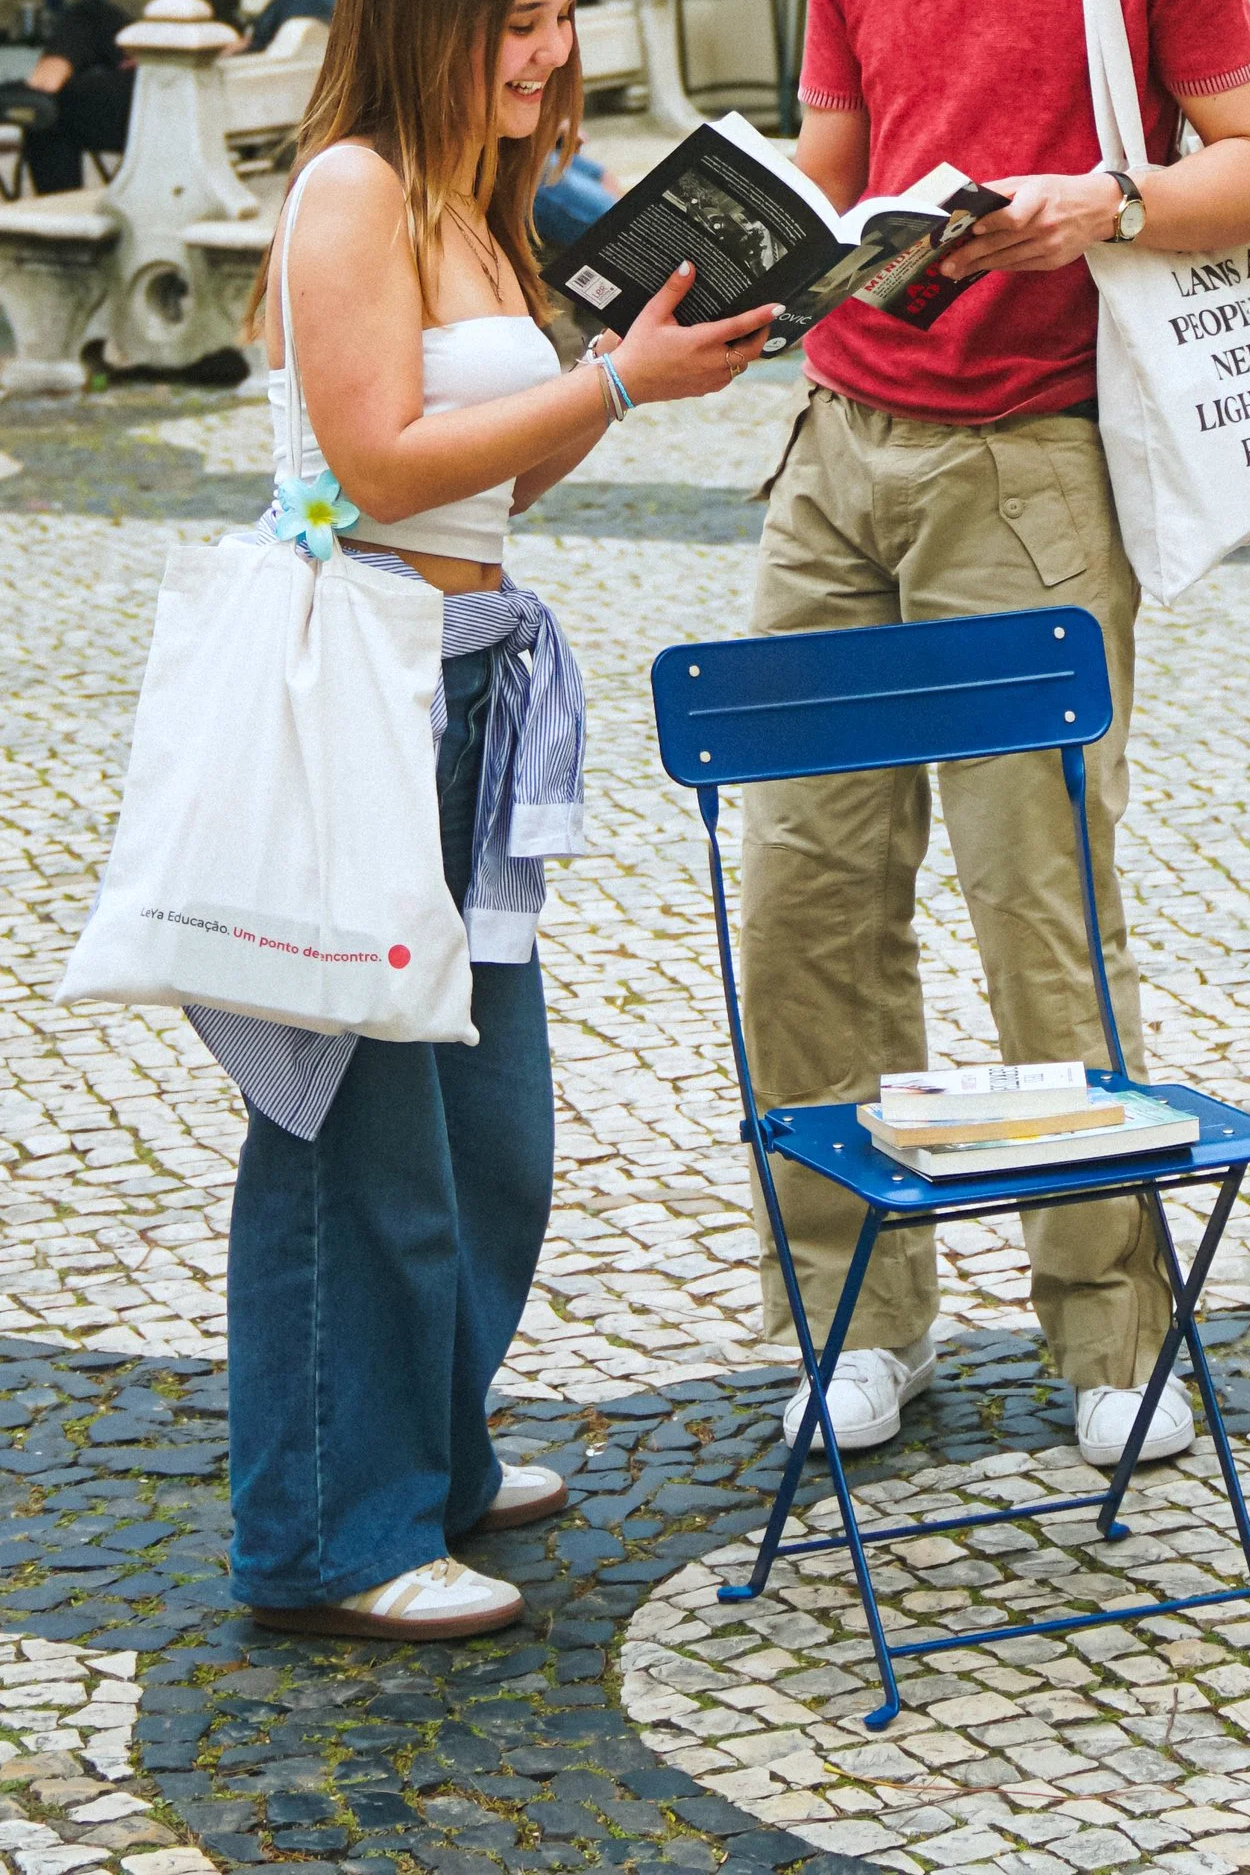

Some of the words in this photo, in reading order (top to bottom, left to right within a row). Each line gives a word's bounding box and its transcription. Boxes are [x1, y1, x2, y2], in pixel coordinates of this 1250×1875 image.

[140, 907, 164, 921] LeYa
[167, 910, 231, 935] Educação.
[233, 926, 256, 943] Um
[259, 936, 299, 955] ponto
[303, 945, 320, 958] de
